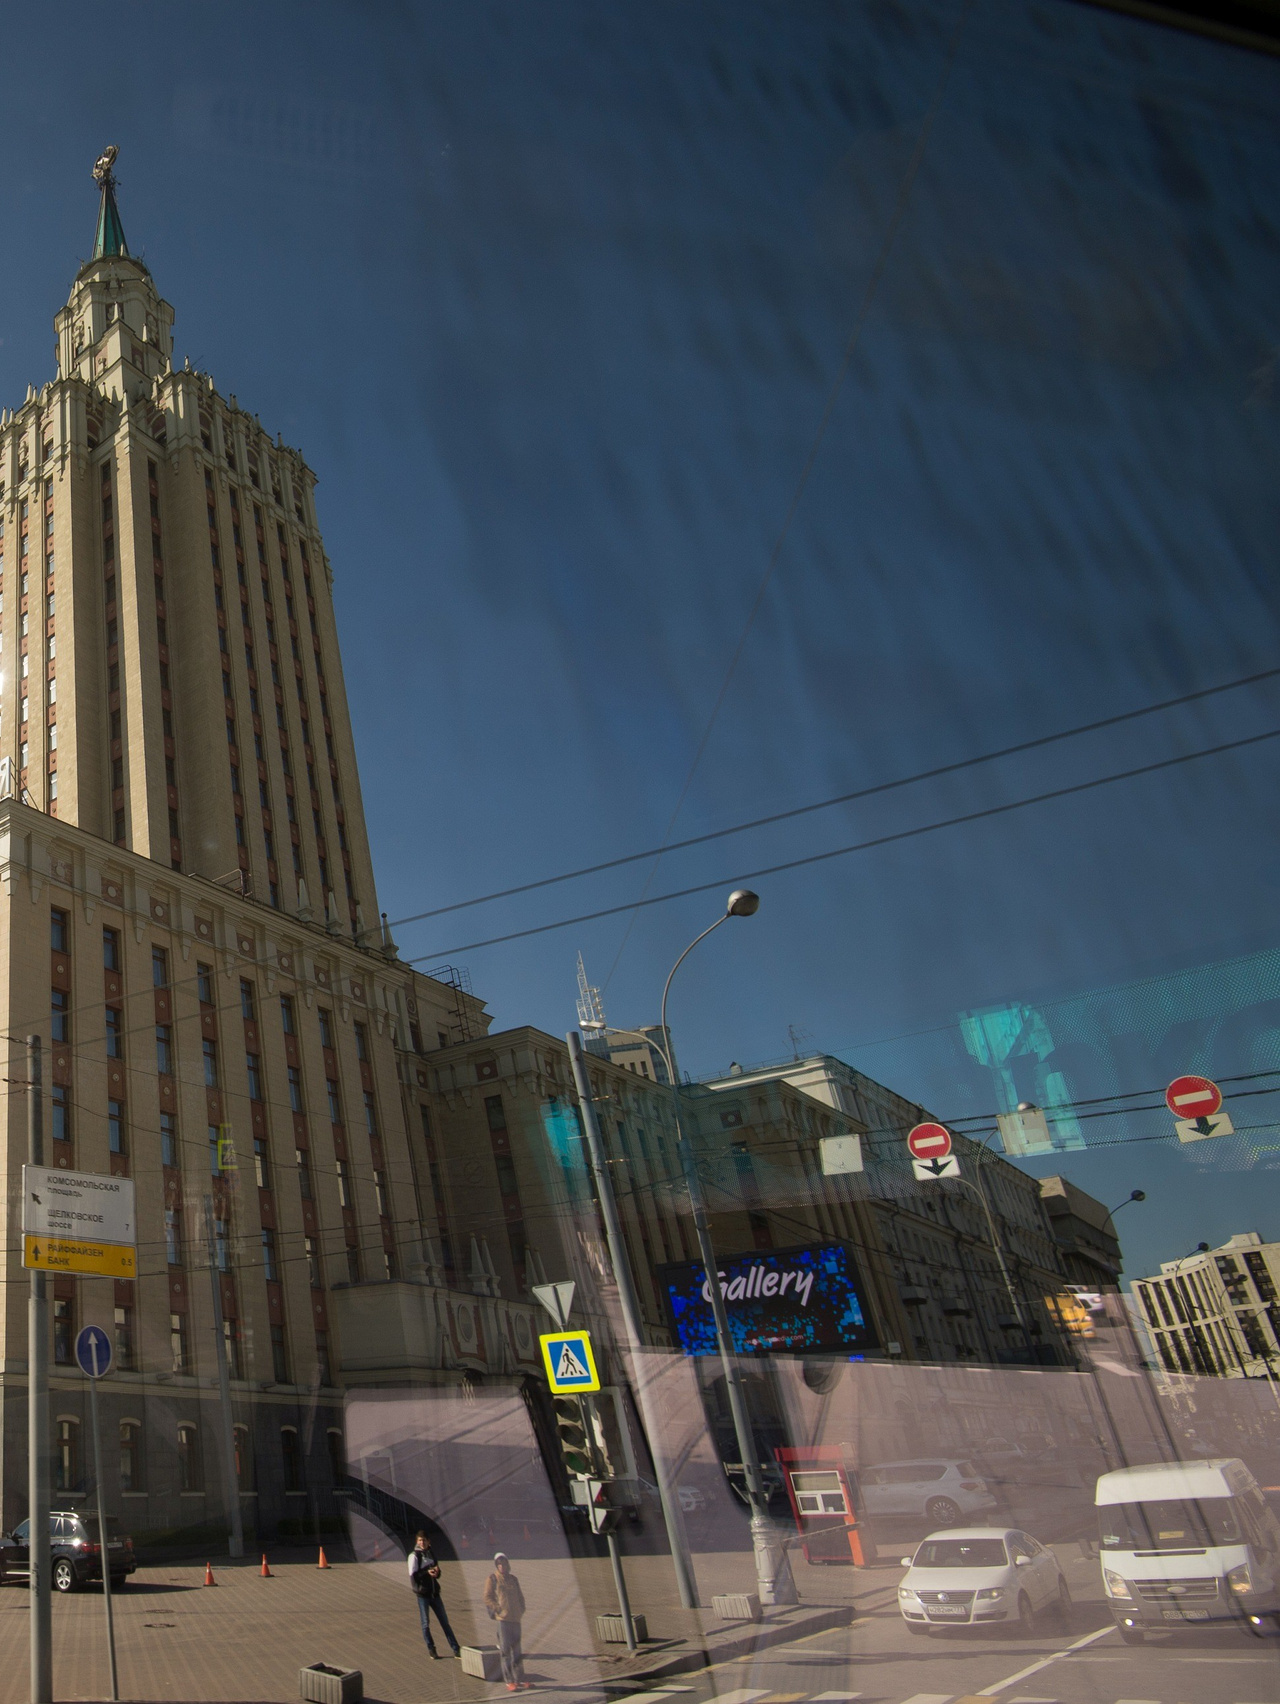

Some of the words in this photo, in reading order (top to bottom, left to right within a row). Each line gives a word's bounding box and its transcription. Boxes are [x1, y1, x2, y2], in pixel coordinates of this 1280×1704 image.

[47, 1175, 120, 1192] КОМСОМОЛЬСКАЯ
[48, 1208, 104, 1223] ЩЕЛКОВСКОЕ
[125, 1223, 130, 1231] 7
[47, 1243, 104, 1257] РАЙФФАЙЗЕН
[47, 1257, 70, 1266] БАНК
